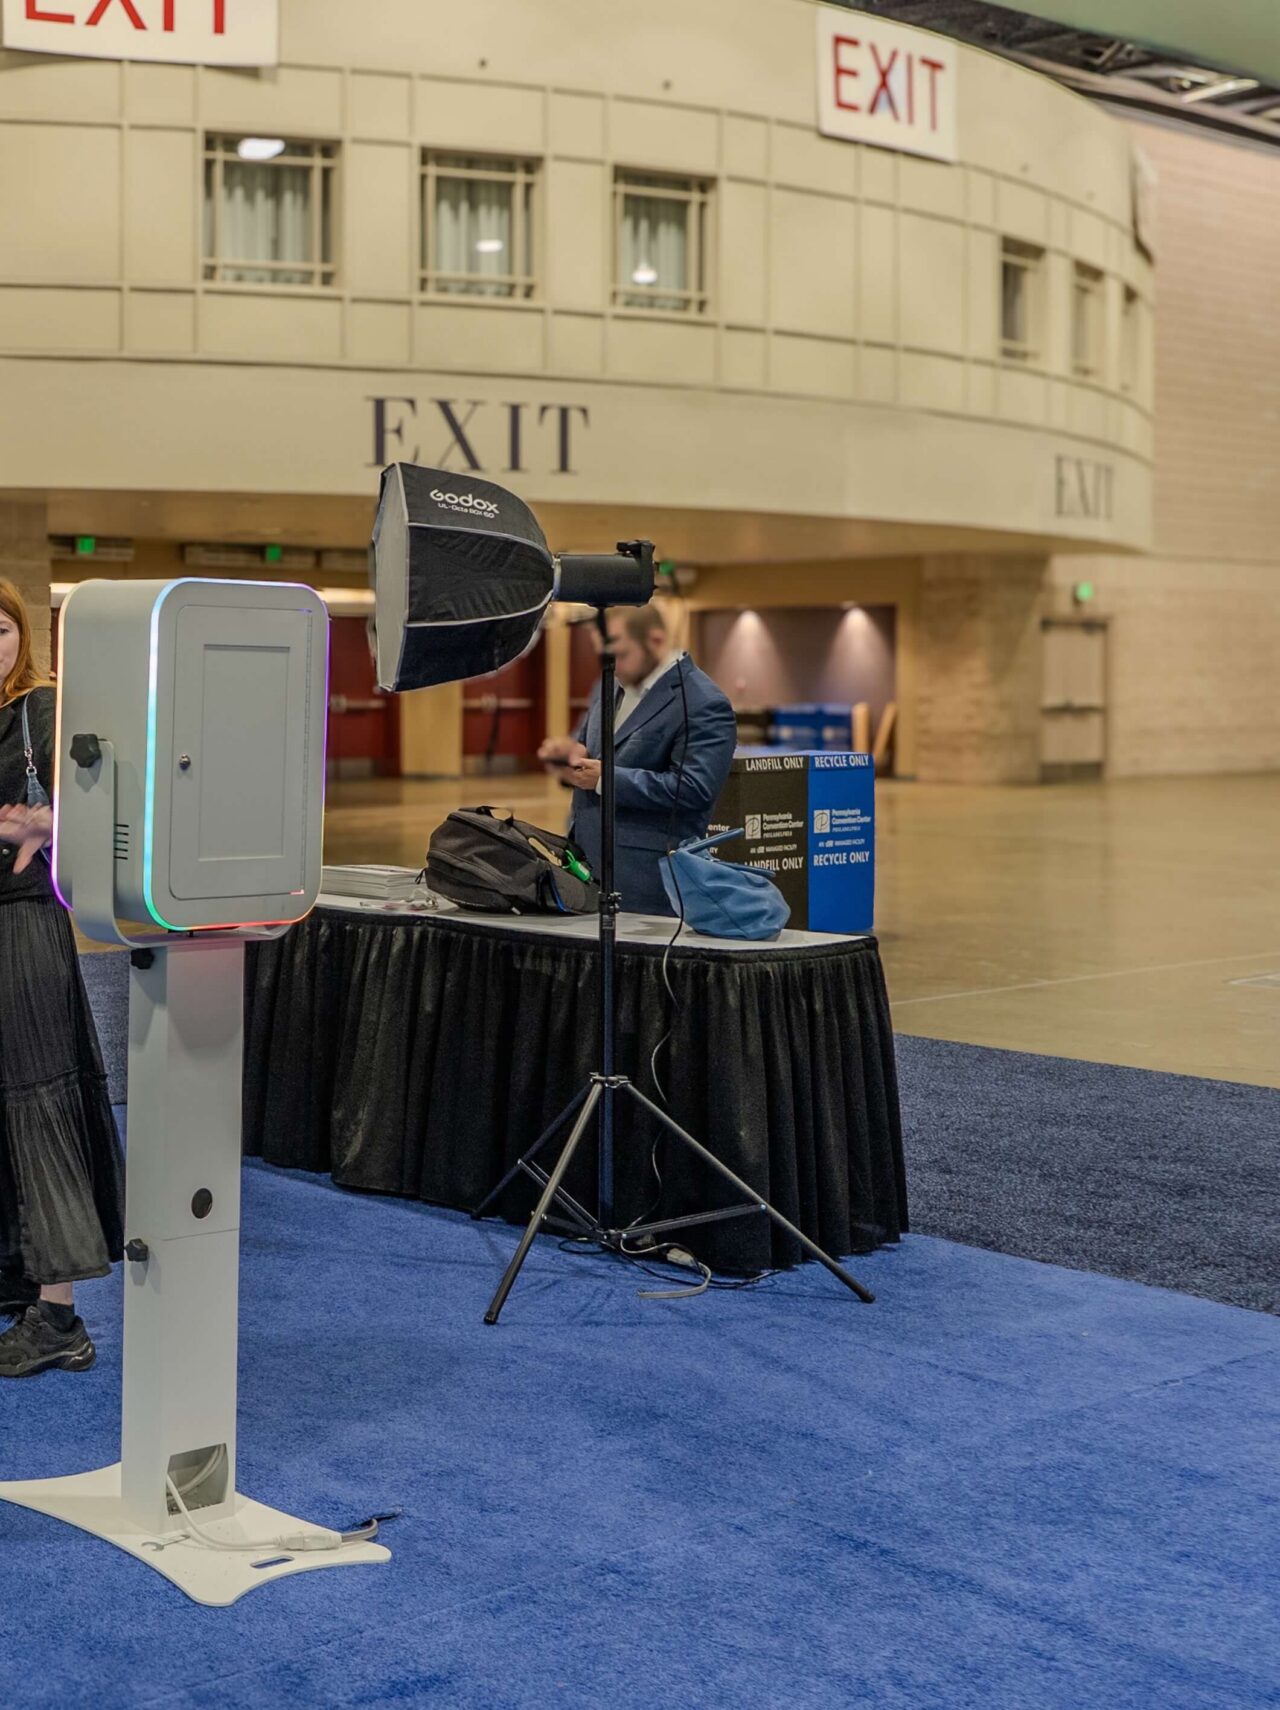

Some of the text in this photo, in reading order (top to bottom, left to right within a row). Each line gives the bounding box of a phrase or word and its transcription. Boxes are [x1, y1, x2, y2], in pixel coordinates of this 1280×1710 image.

[832, 33, 945, 132] EXIT
[366, 395, 590, 475] EXIT
[1055, 454, 1115, 520] EXIT
[429, 488, 500, 514] Godox
[745, 757, 804, 771] LANDFILL ONLY
[814, 754, 869, 768] RECYCLE ONLY
[782, 856, 804, 870] ONLY
[813, 851, 870, 866] RECYCLE ONLY
